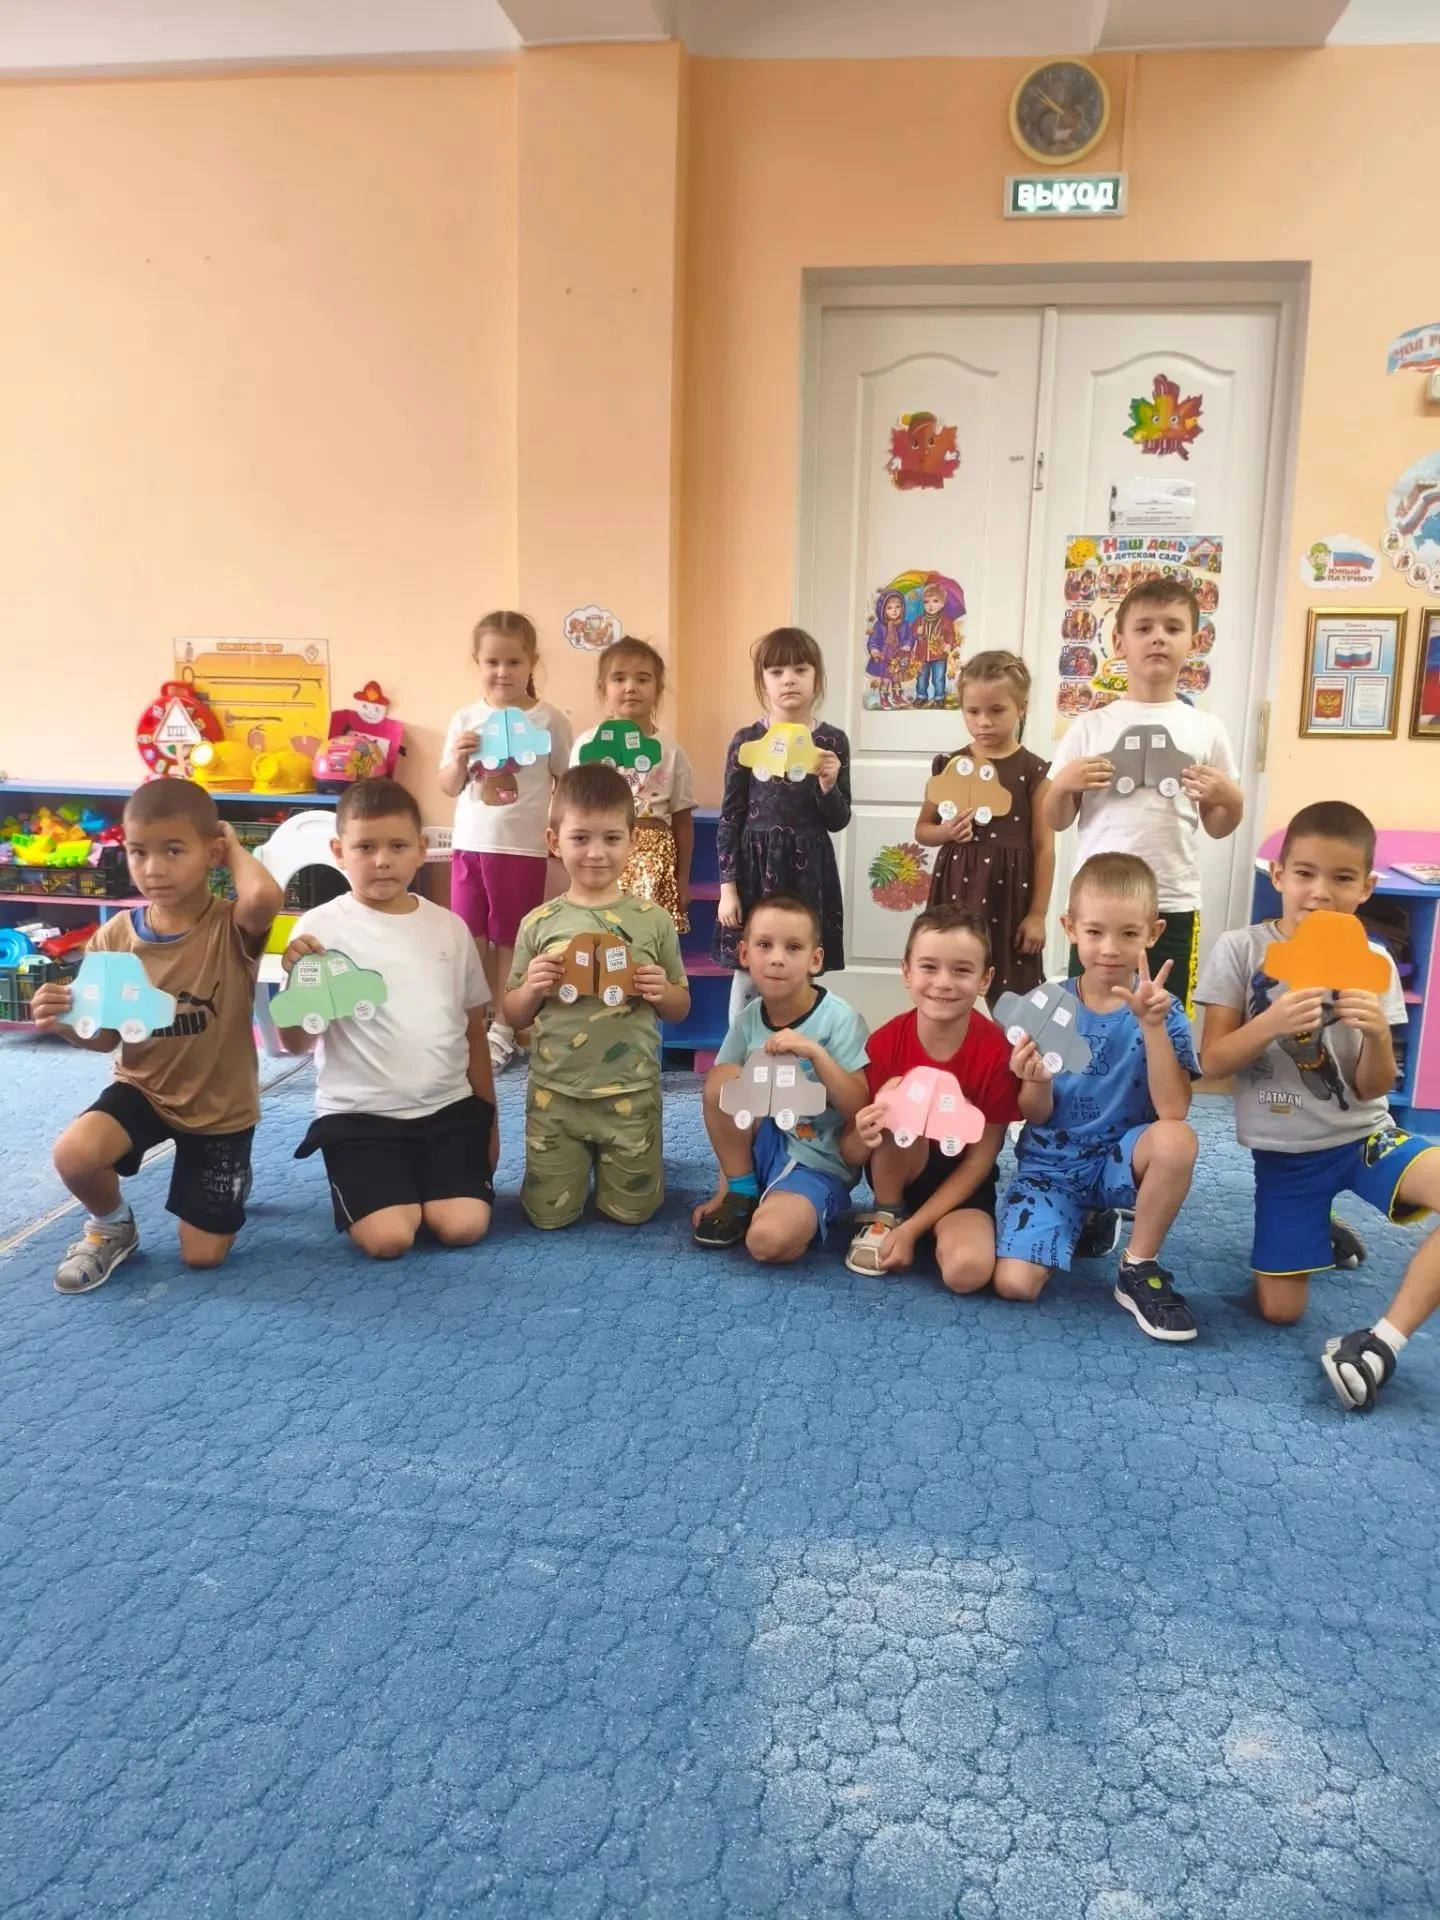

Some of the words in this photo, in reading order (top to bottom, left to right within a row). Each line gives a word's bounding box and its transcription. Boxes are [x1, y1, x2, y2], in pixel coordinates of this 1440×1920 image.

[1018, 182, 1114, 207] ВЫХОД
[1102, 537, 1144, 553] Наш
[1115, 551, 1156, 561] детском
[1159, 552, 1183, 563] саду
[1259, 1089, 1303, 1108] BATMAN
